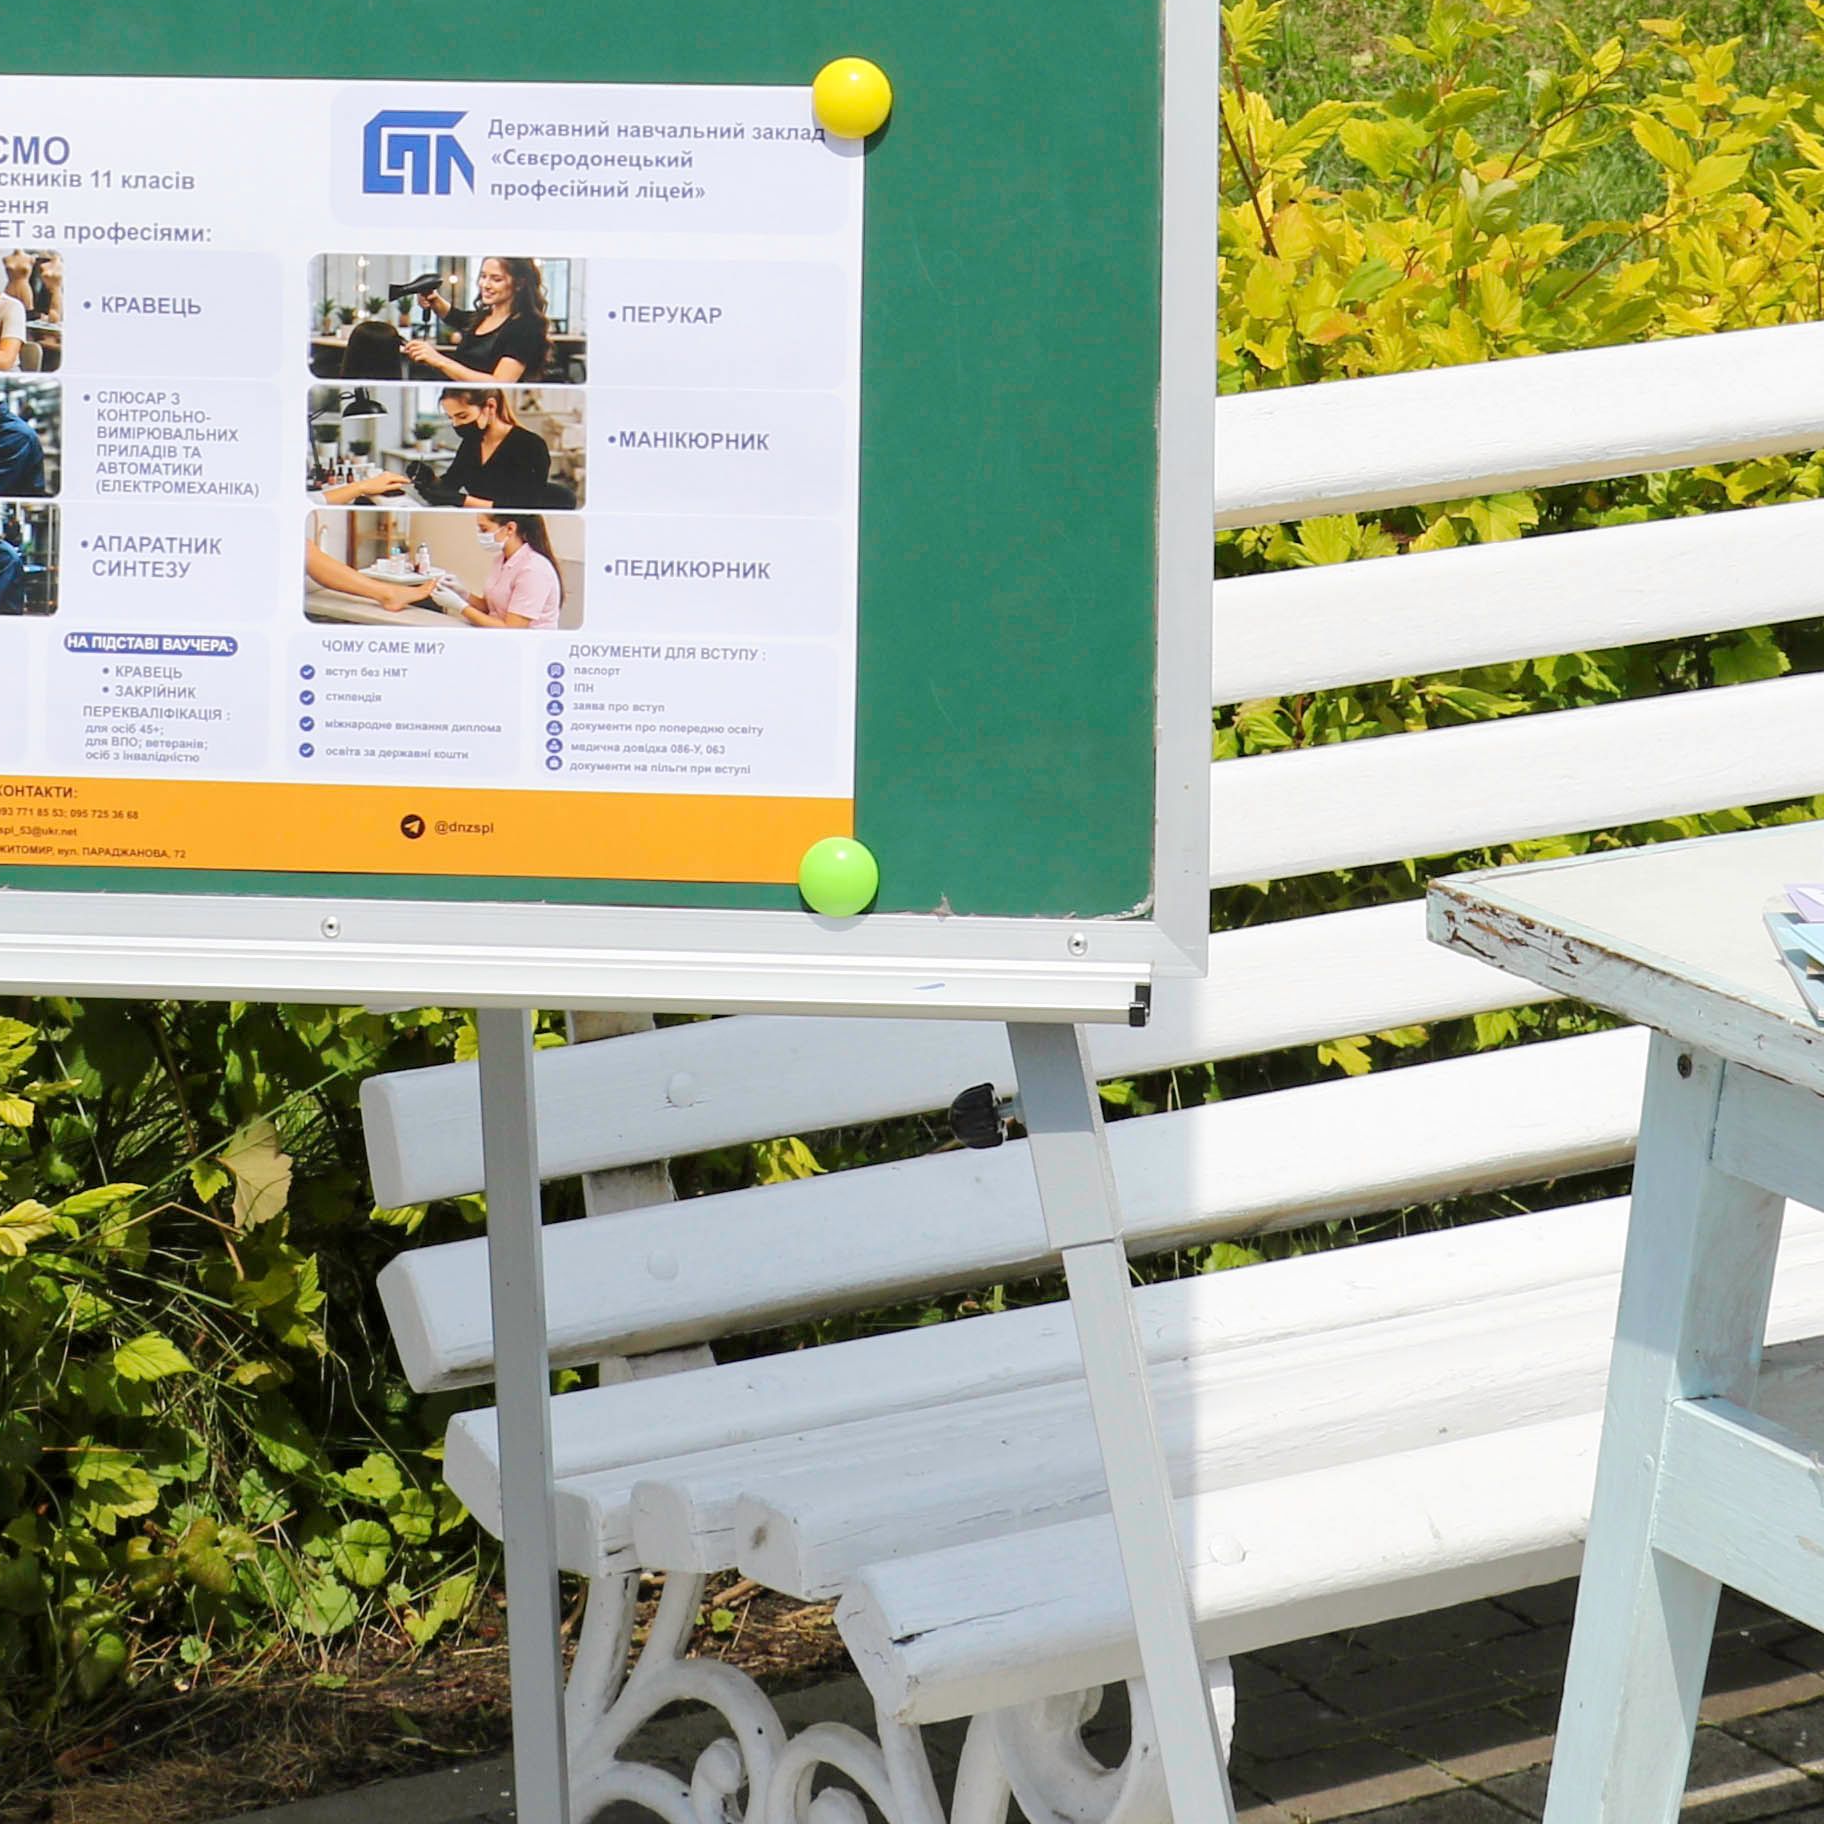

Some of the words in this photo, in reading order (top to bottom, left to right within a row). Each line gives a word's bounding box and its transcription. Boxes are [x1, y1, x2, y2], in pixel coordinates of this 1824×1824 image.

[488, 118, 610, 142] Державний
[617, 120, 745, 142] навчальний
[751, 122, 826, 145] заклад
[491, 146, 694, 174] «Сєвєродонецький
[90, 170, 113, 189] 11
[121, 171, 196, 191] класів
[490, 178, 630, 204] професійний
[636, 179, 706, 204] ліцей»
[32, 223, 56, 240] за
[64, 221, 213, 244] професіями:
[100, 295, 203, 317] КРАВЕЦЬ
[621, 304, 723, 326] ПЕРУКАР
[96, 390, 168, 406] СЛЮСАР
[96, 409, 212, 424] КОНТРОЛЬНО-
[96, 426, 240, 443] ВИМІРЮВАЛЬНИХ
[618, 430, 770, 452] МАНІКЮРНИК
[96, 444, 178, 460] ПРИЛАДІВ
[182, 444, 202, 459] ТА
[95, 461, 204, 477] АВТОМАТИКИ
[95, 478, 261, 497] (ЕЛЕКТРОМЕХАНІКА)
[92, 534, 222, 556] АПАРАТНИК
[92, 558, 192, 579] СИНТЕЗУ
[614, 558, 771, 581] ПЕДИКЮРНИК
[67, 636, 87, 648] НА
[92, 636, 159, 651] ПІДСТАВІ
[162, 638, 233, 652] ВАУЧЕРА:
[322, 640, 364, 653] ЧОМУ
[369, 641, 409, 654] САМЕ
[414, 643, 445, 655] МИ?
[569, 645, 661, 659] ДОКУМЕНТИ
[665, 647, 696, 660] ДЛЯ
[701, 648, 758, 661] ВСТУПУ
[115, 665, 183, 680] КРАВЕЦЬ
[115, 684, 197, 699] ЗАКРІЙНИК
[83, 705, 223, 722] ПЕРЕКВАЛІФІКАЦІЯ
